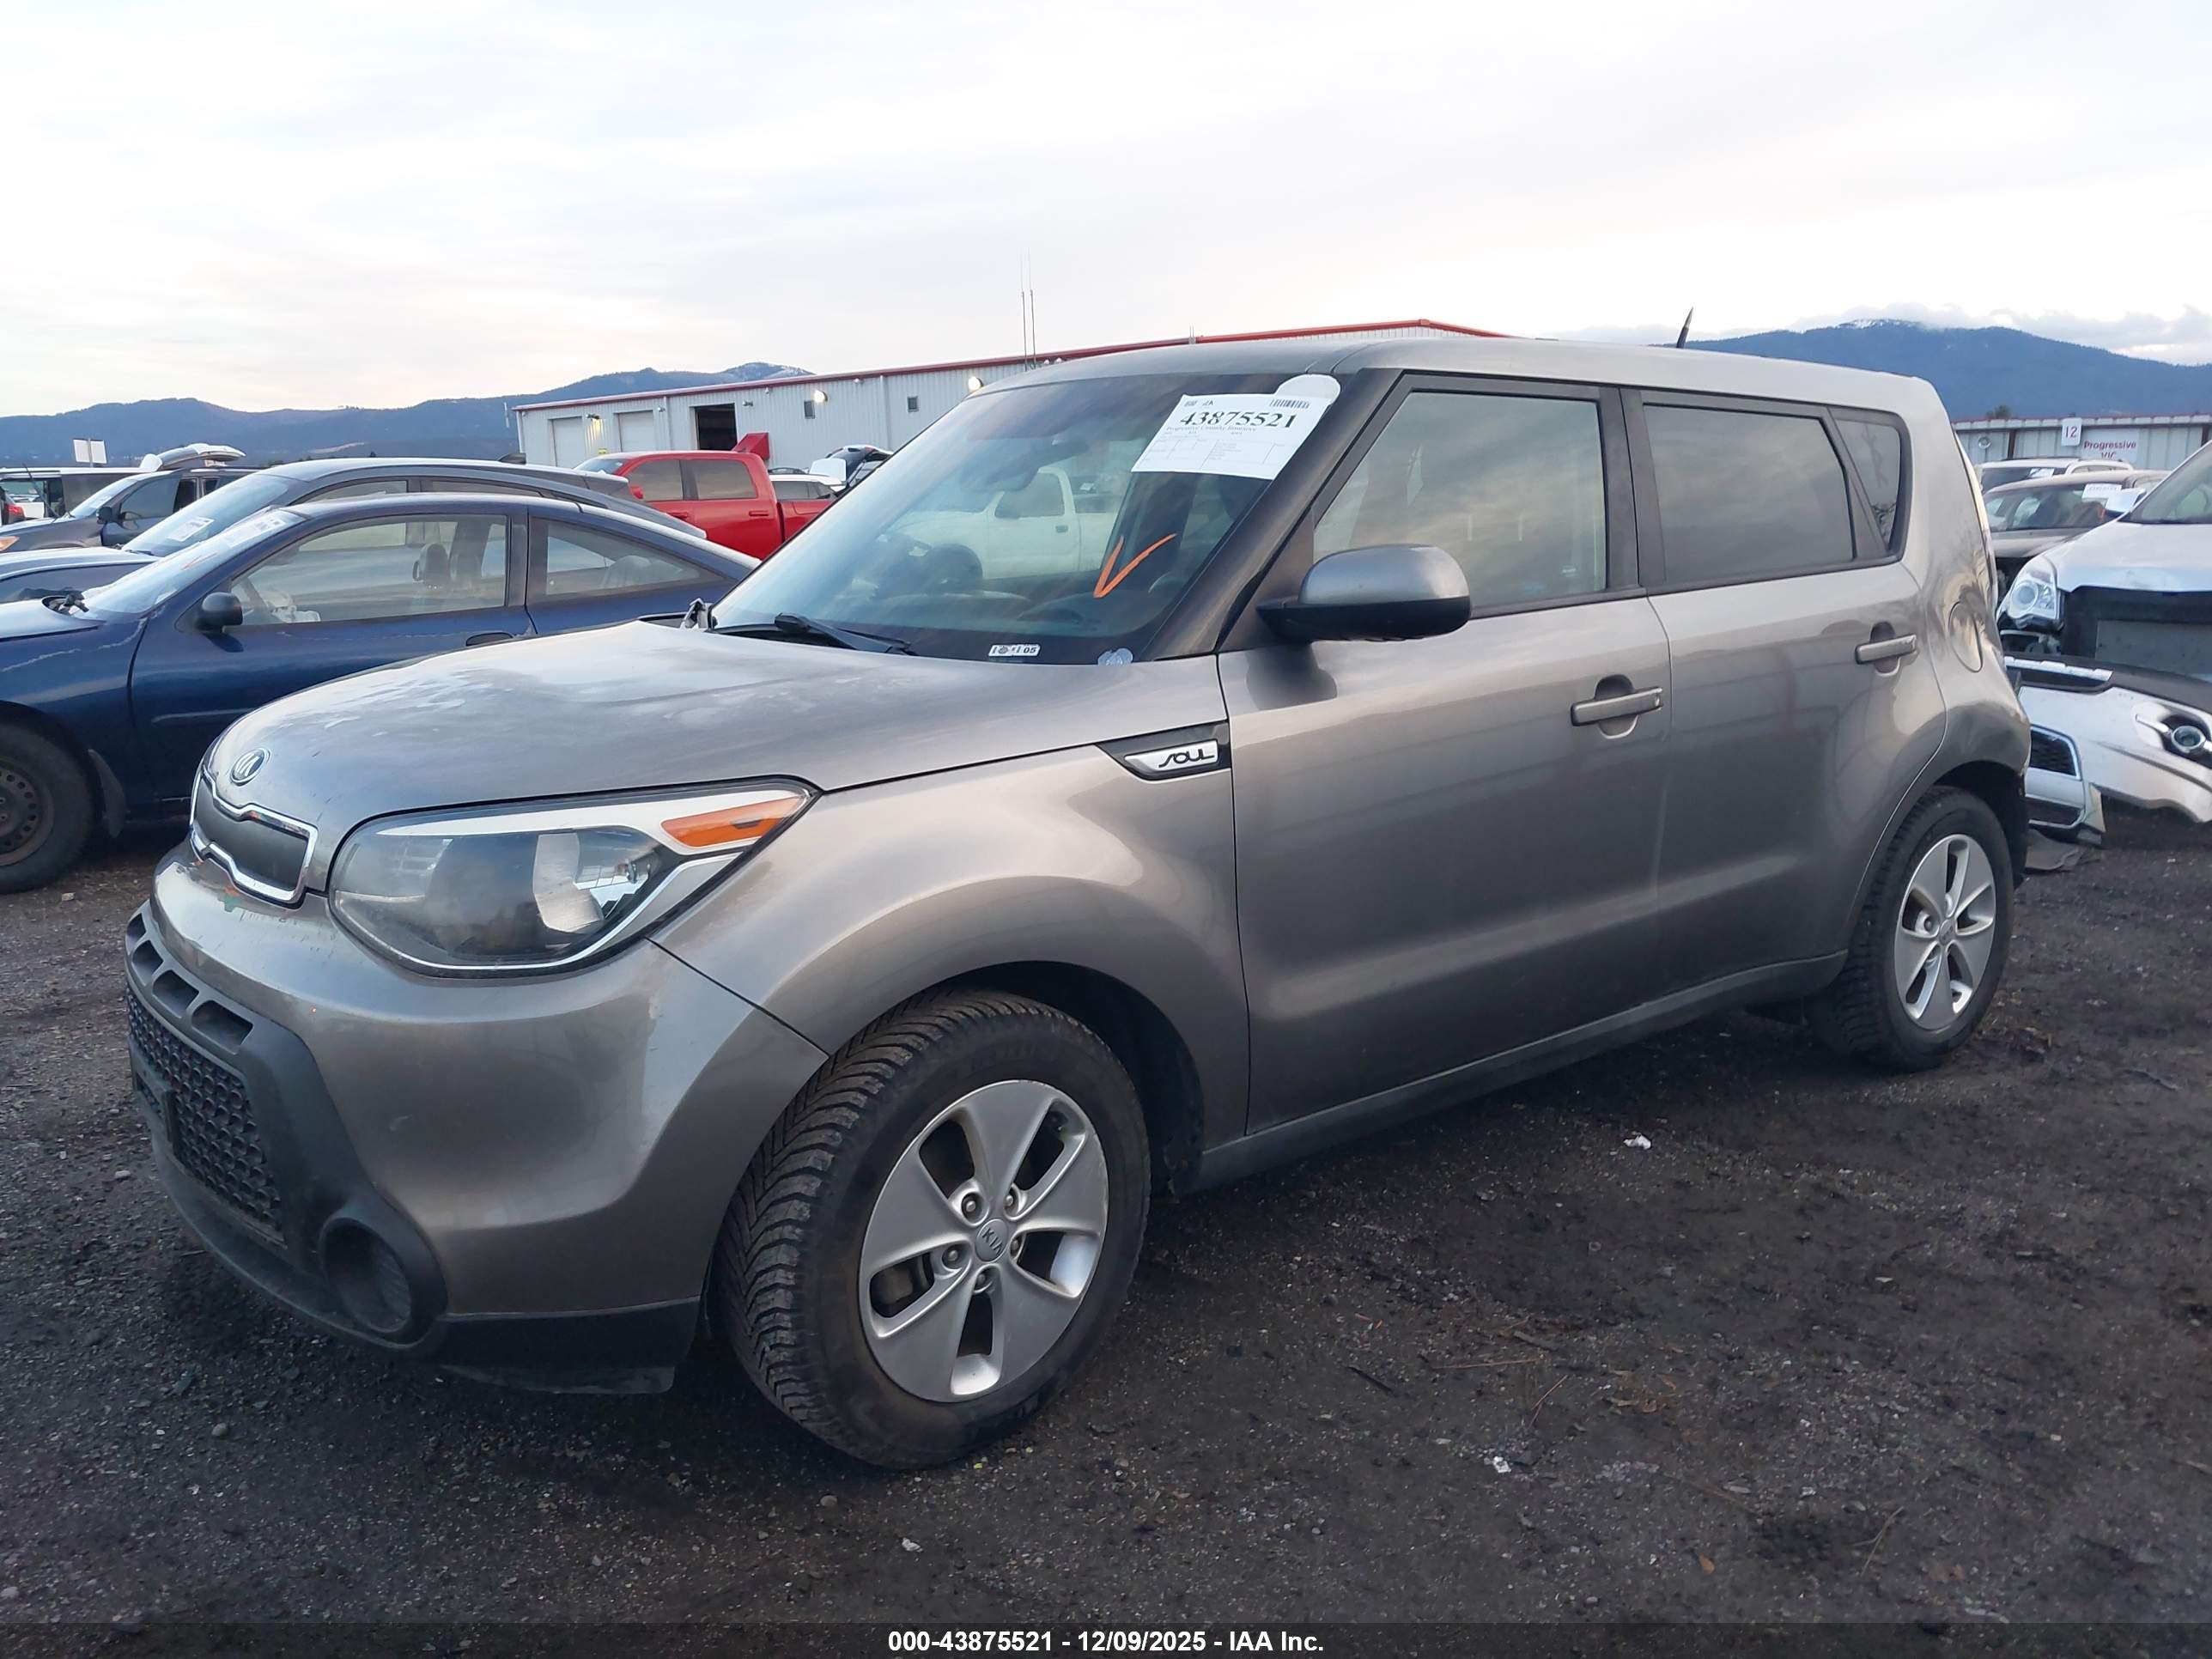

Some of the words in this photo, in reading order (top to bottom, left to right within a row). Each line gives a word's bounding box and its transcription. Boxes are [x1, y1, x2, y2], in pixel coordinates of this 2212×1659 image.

[1180, 411, 1297, 428] 43875521
[2066, 426, 2078, 438] 12
[2084, 440, 2136, 450] Progressive
[1158, 749, 1215, 769] SOUL
